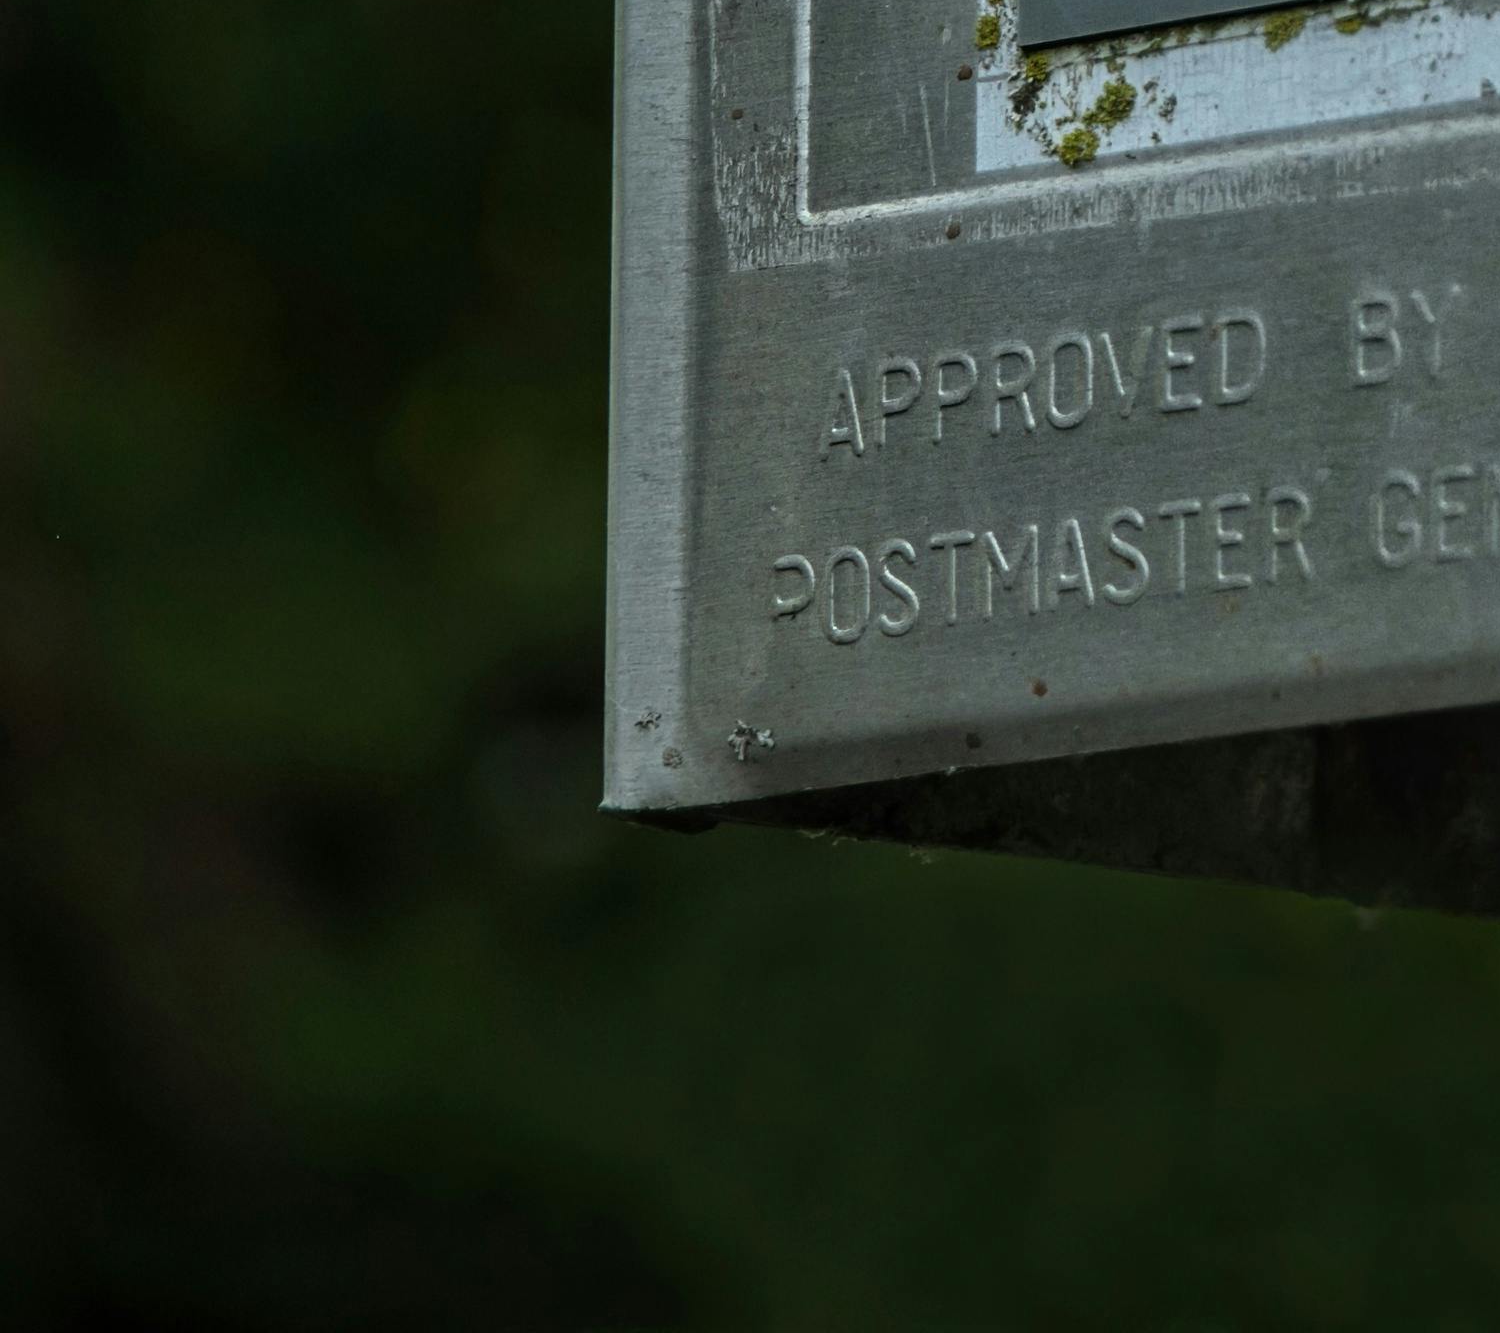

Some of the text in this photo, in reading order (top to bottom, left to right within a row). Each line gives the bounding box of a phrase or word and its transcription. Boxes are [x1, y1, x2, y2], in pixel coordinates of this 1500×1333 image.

[818, 307, 1268, 461] APPROVED
[1347, 279, 1466, 390] BY
[771, 483, 1318, 648] POSTMASTER
